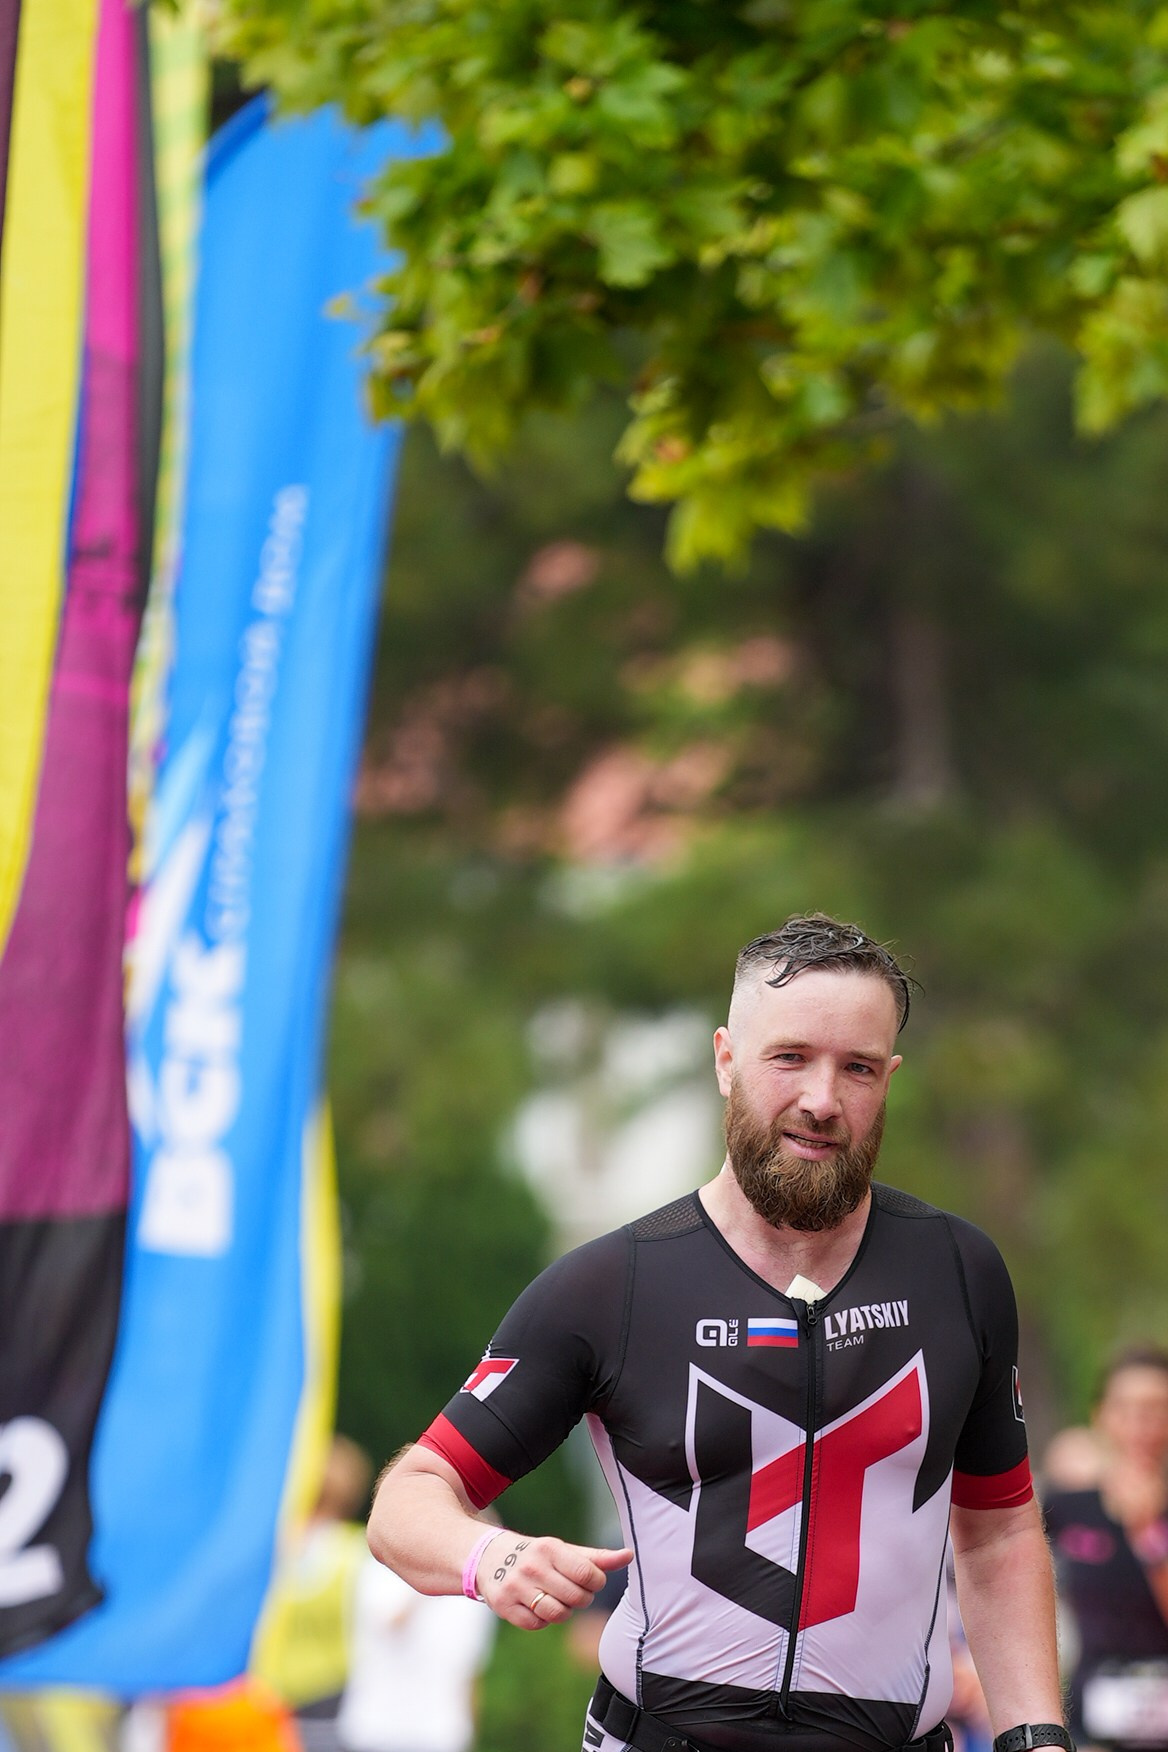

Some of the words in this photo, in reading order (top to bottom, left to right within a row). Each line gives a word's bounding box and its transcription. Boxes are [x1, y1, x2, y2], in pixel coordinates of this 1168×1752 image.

[824, 1300, 909, 1341] LYATSKIY
[827, 1334, 864, 1352] TEAM
[493, 1541, 531, 1582] 366
